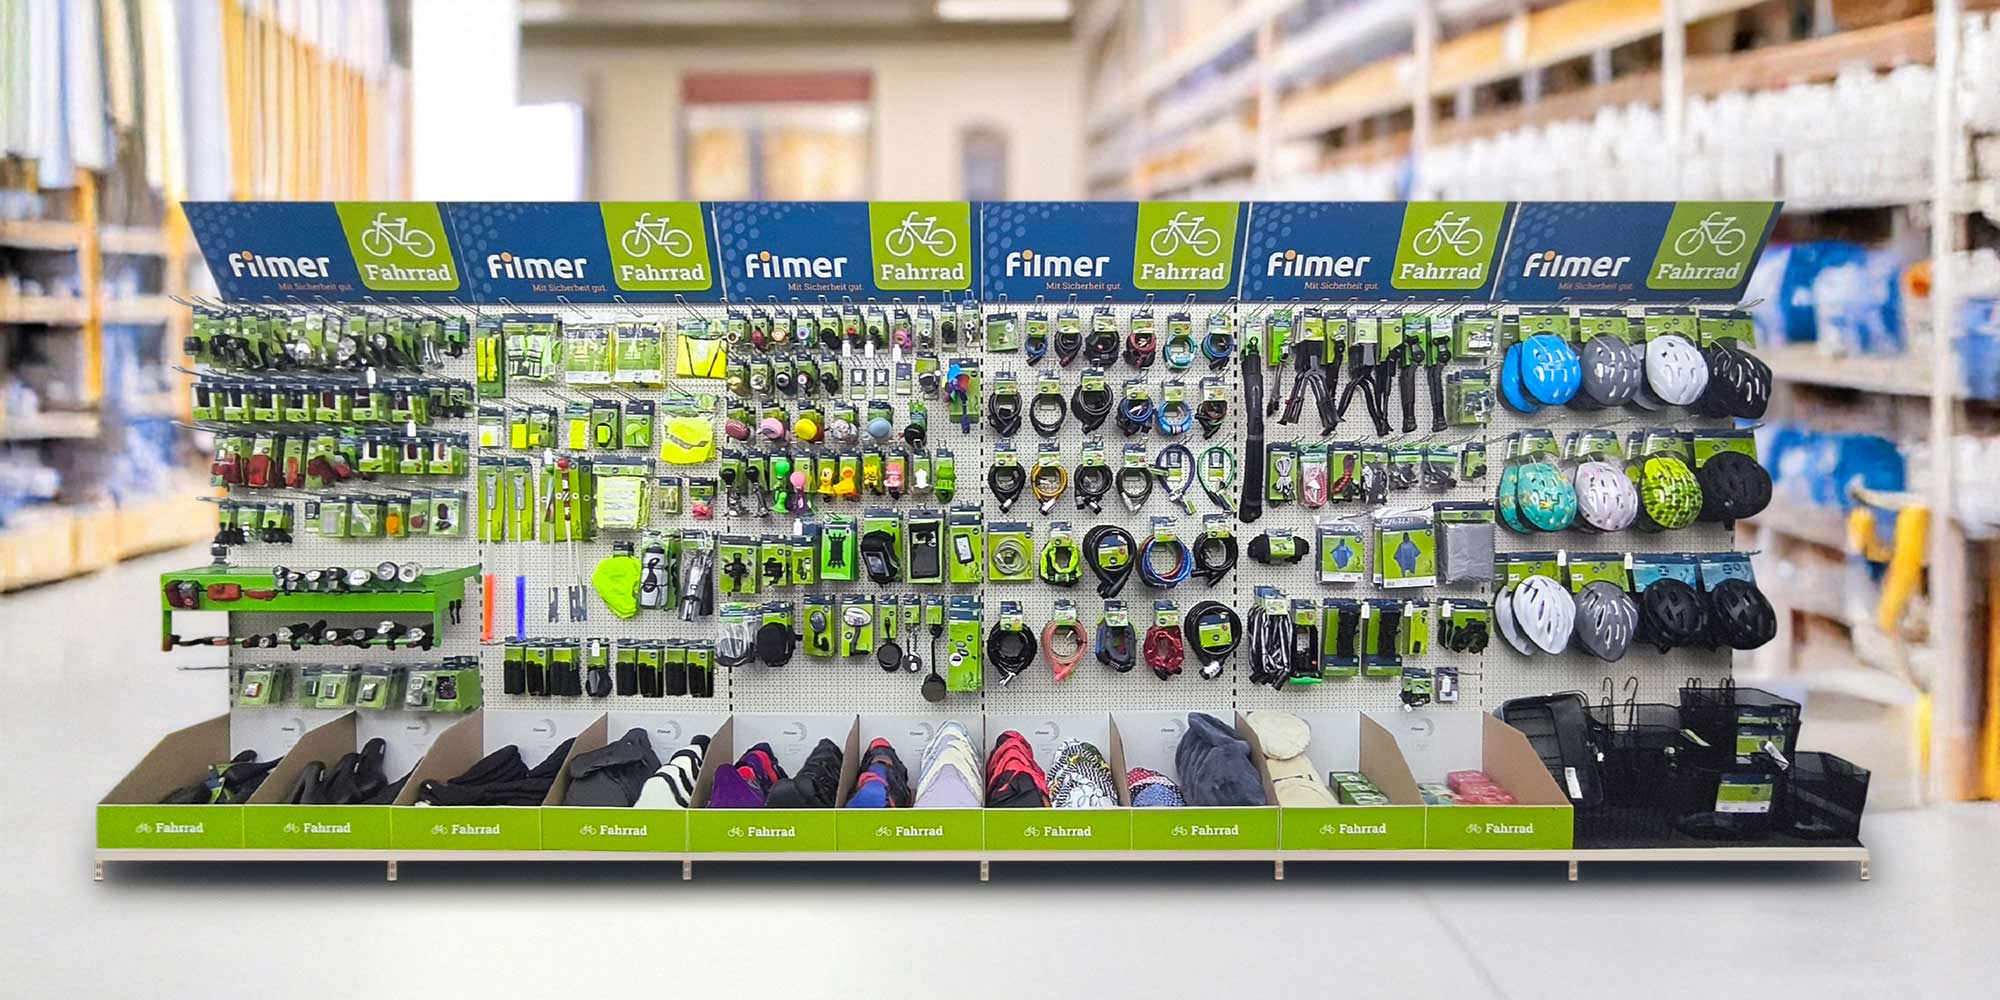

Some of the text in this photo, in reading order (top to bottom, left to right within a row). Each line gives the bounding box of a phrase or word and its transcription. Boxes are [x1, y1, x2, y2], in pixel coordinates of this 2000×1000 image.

[229, 251, 330, 278] filmer
[487, 251, 587, 279] filmer
[745, 250, 848, 279] filmer
[1006, 250, 1110, 278] filmer
[1268, 250, 1371, 277] filmer
[1523, 250, 1631, 278] filmer
[366, 263, 452, 282] Fahrrad
[621, 263, 704, 282] Fahrrad
[881, 263, 965, 281] Fahrrad
[1141, 262, 1225, 281] Fahrrad
[1400, 262, 1483, 280] Fahrrad
[1657, 262, 1742, 281] Fahrrad
[788, 283, 802, 291] Mit
[804, 283, 847, 292] Sicherheit
[1046, 282, 1061, 291] Mit
[1062, 282, 1105, 291] Sicherheit
[1304, 281, 1319, 290] Mit
[156, 822, 204, 834] Fahrrad
[303, 822, 351, 834] Fahrrad
[451, 823, 500, 836] Fahrrad
[599, 824, 648, 837] Fahrrad
[748, 825, 796, 837] Fahrrad
[895, 825, 943, 837] Fahrrad
[1044, 825, 1092, 837] Fahrrad
[1191, 824, 1239, 836] Fahrrad
[1339, 823, 1387, 834] Fahrrad
[1486, 823, 1534, 834] Fahrrad
